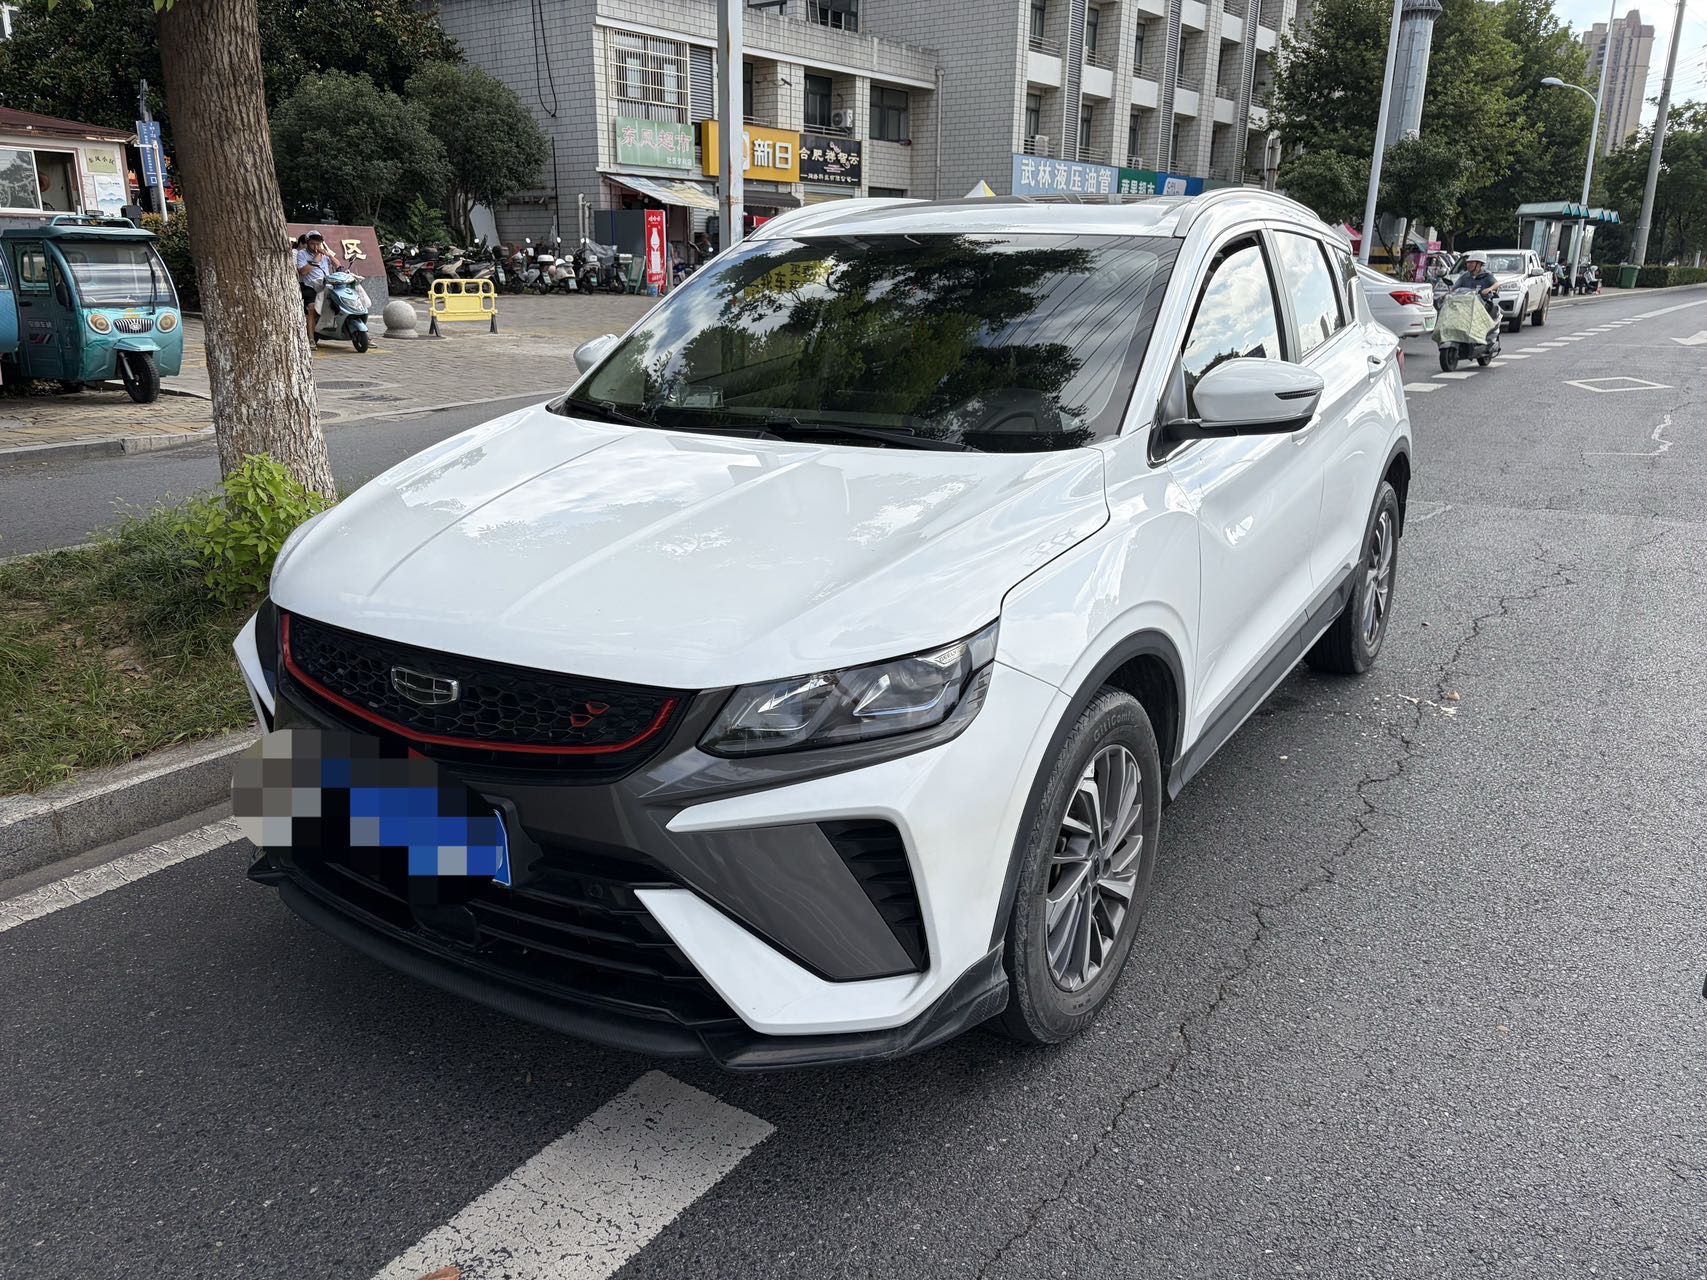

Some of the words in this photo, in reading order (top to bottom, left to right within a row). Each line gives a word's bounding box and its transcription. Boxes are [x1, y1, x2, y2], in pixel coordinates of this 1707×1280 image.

[754, 138, 793, 170] 新日
[1021, 159, 1112, 194] 武林液压油管
